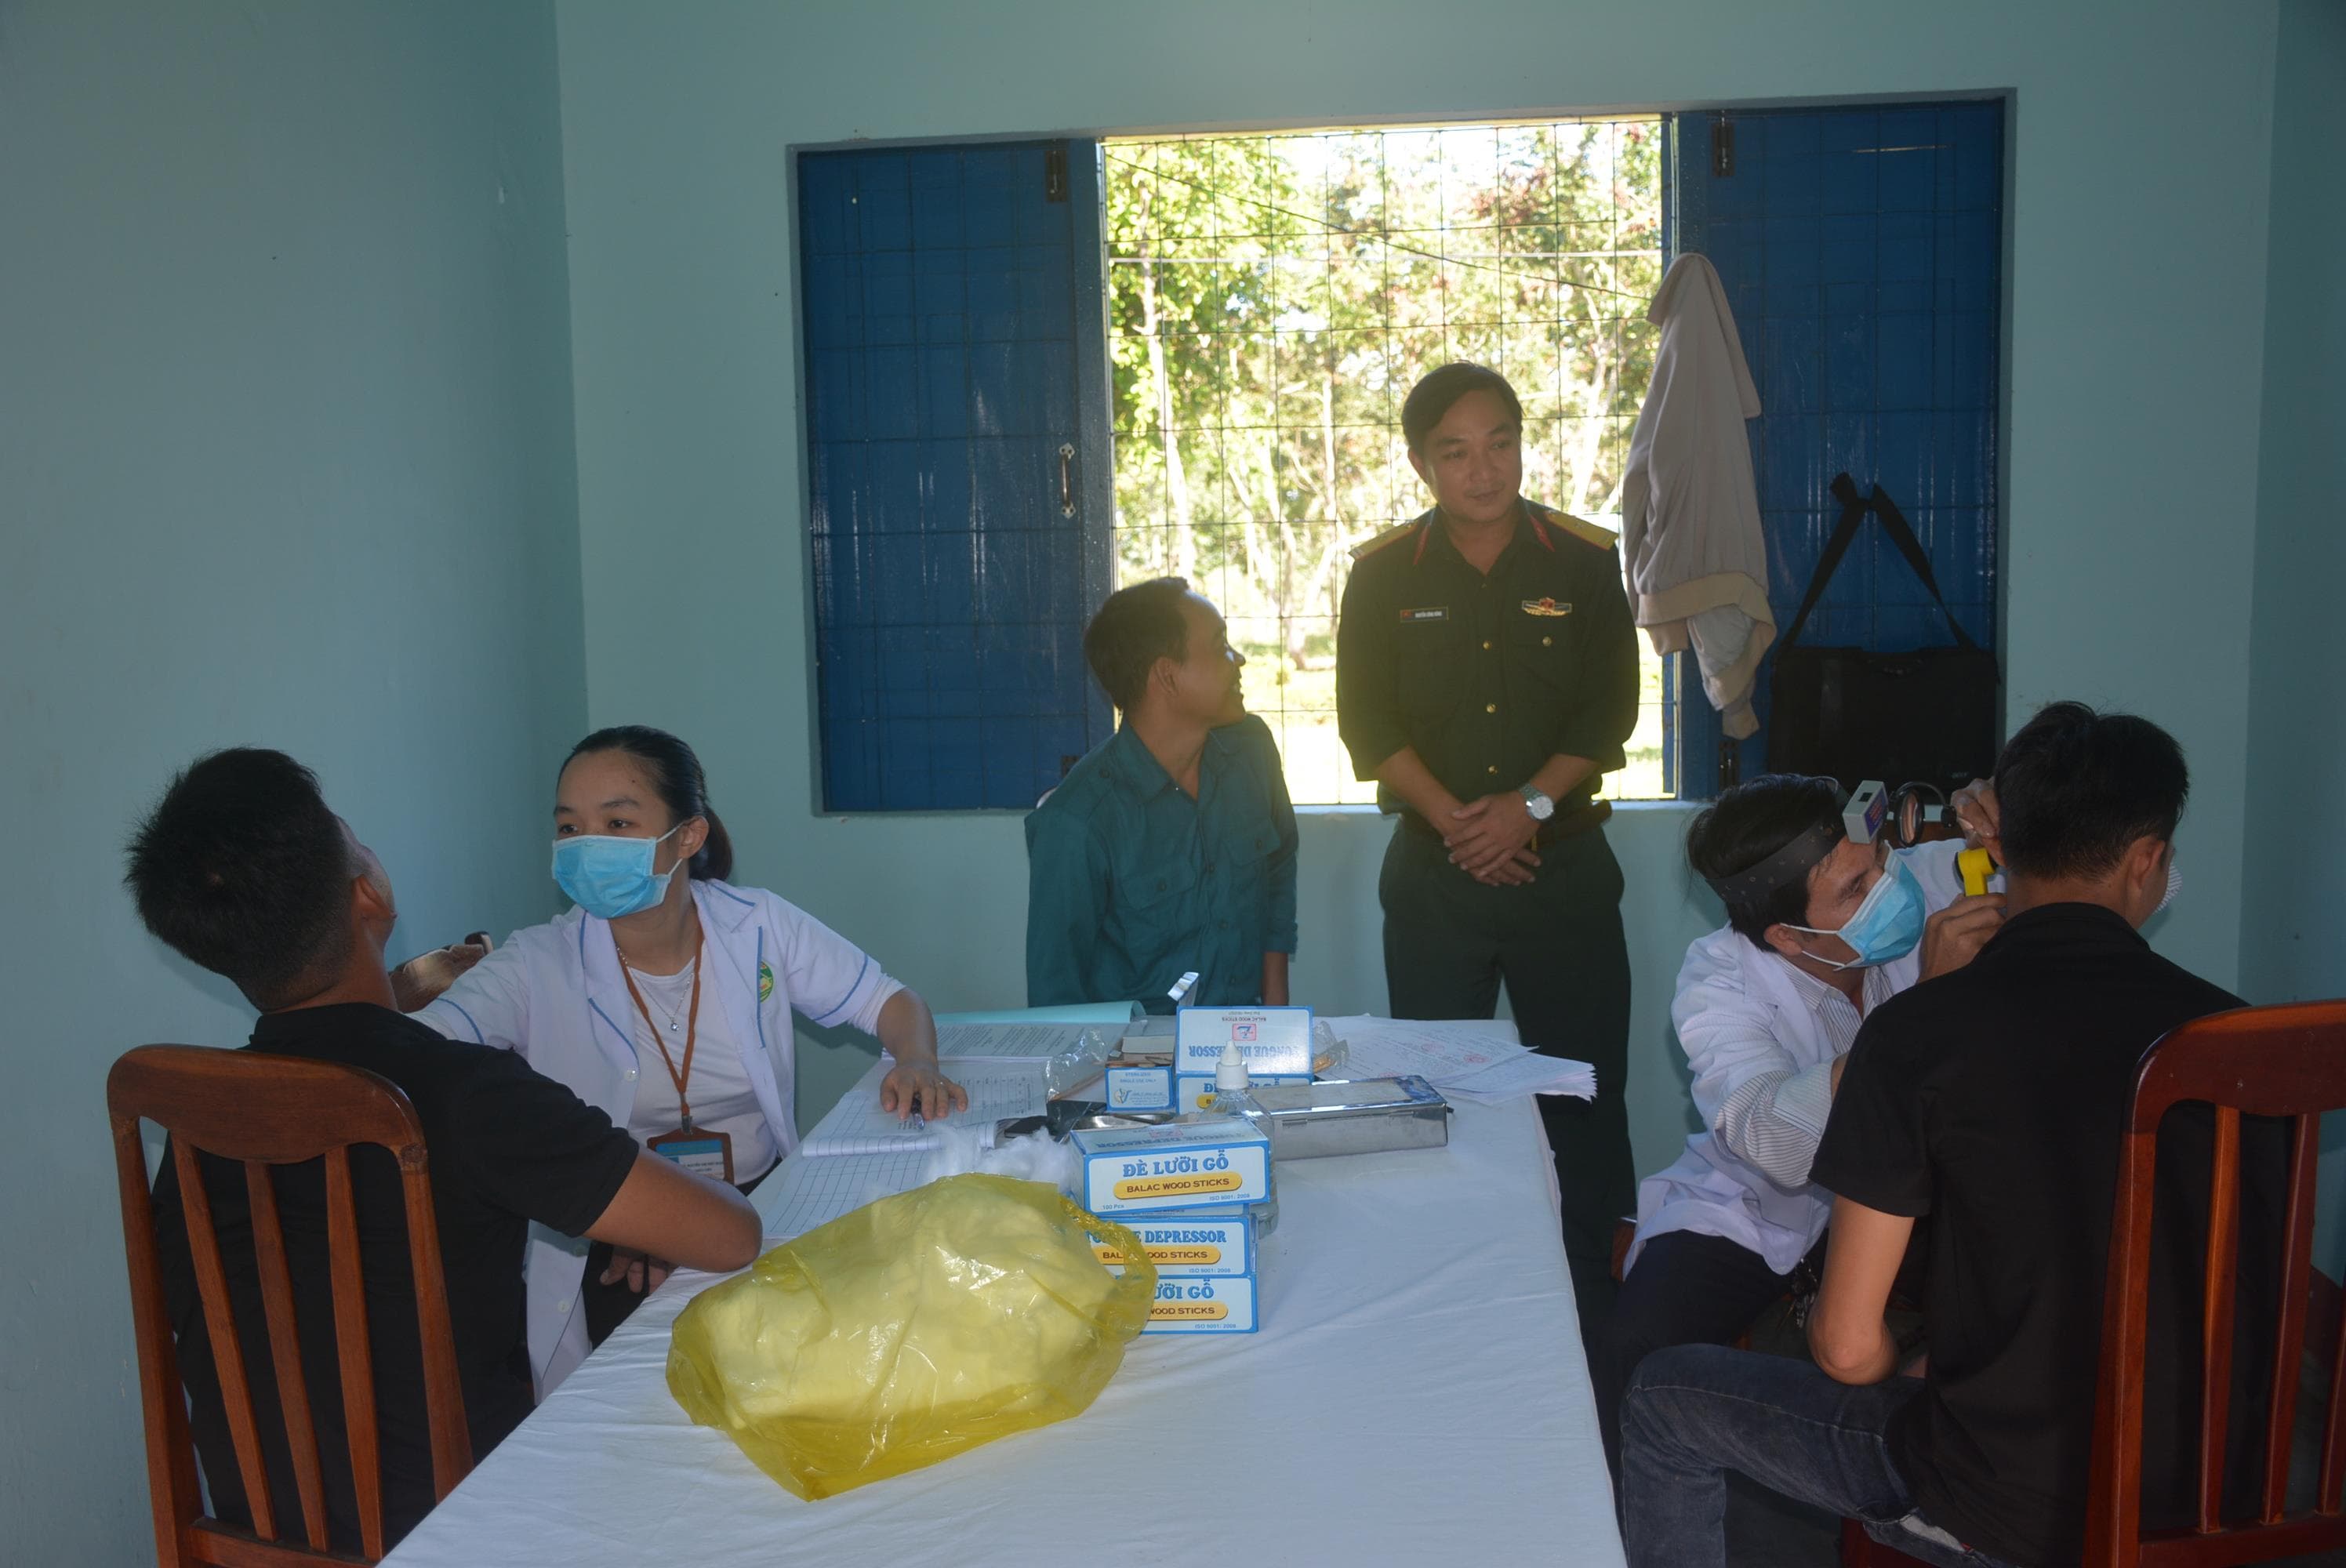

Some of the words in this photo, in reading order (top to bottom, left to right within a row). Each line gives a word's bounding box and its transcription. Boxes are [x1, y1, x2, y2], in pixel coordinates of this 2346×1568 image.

[1123, 1159, 1149, 1178] ĐÈ
[1153, 1156, 1199, 1175] LƯỠI
[1202, 1149, 1229, 1171] GỖ
[1127, 1184, 1160, 1193] BALAC
[1163, 1181, 1191, 1190] WOOD
[1193, 1178, 1230, 1188] STICKS
[1144, 1230, 1227, 1243] DEPRESSOR
[1153, 1283, 1182, 1300] ƯỠI
[1187, 1278, 1215, 1299] GỖ
